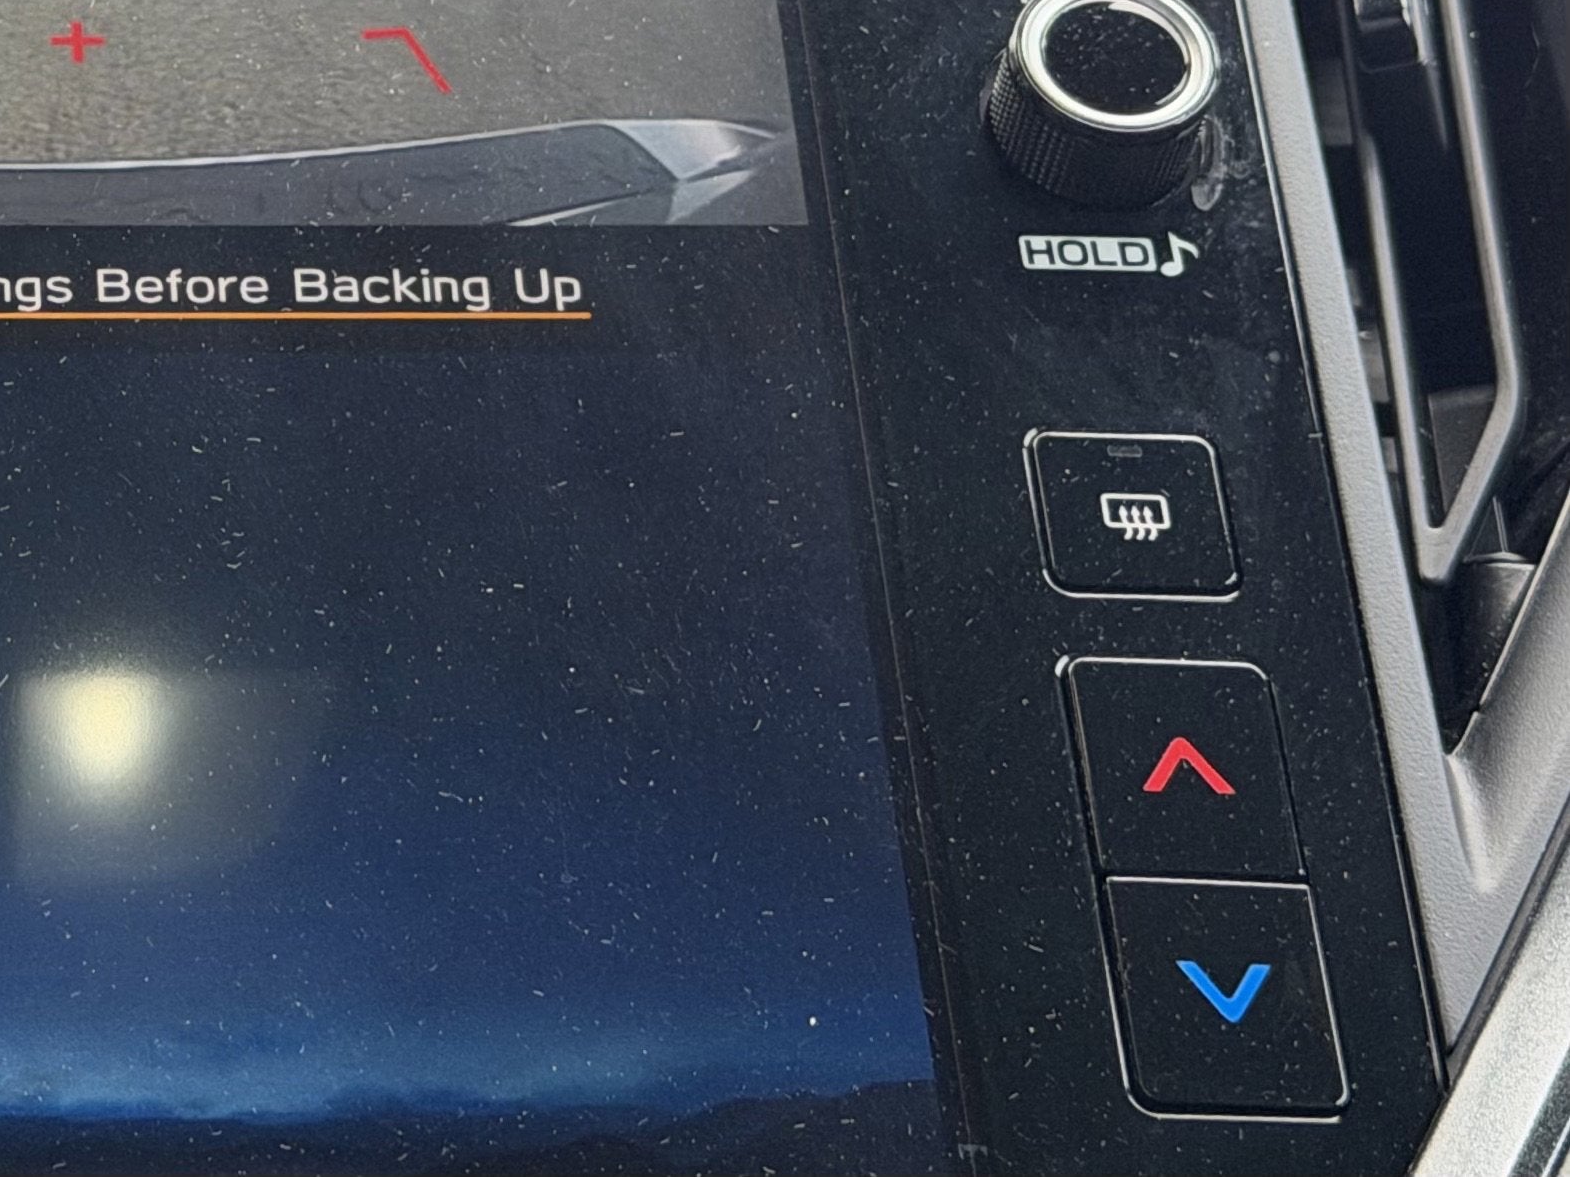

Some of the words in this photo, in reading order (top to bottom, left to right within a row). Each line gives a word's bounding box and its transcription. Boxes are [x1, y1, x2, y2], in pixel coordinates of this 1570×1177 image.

[1024, 240, 1151, 266] HOLD
[95, 267, 270, 304] Before
[293, 268, 491, 312] Backing
[514, 268, 582, 312] Up
